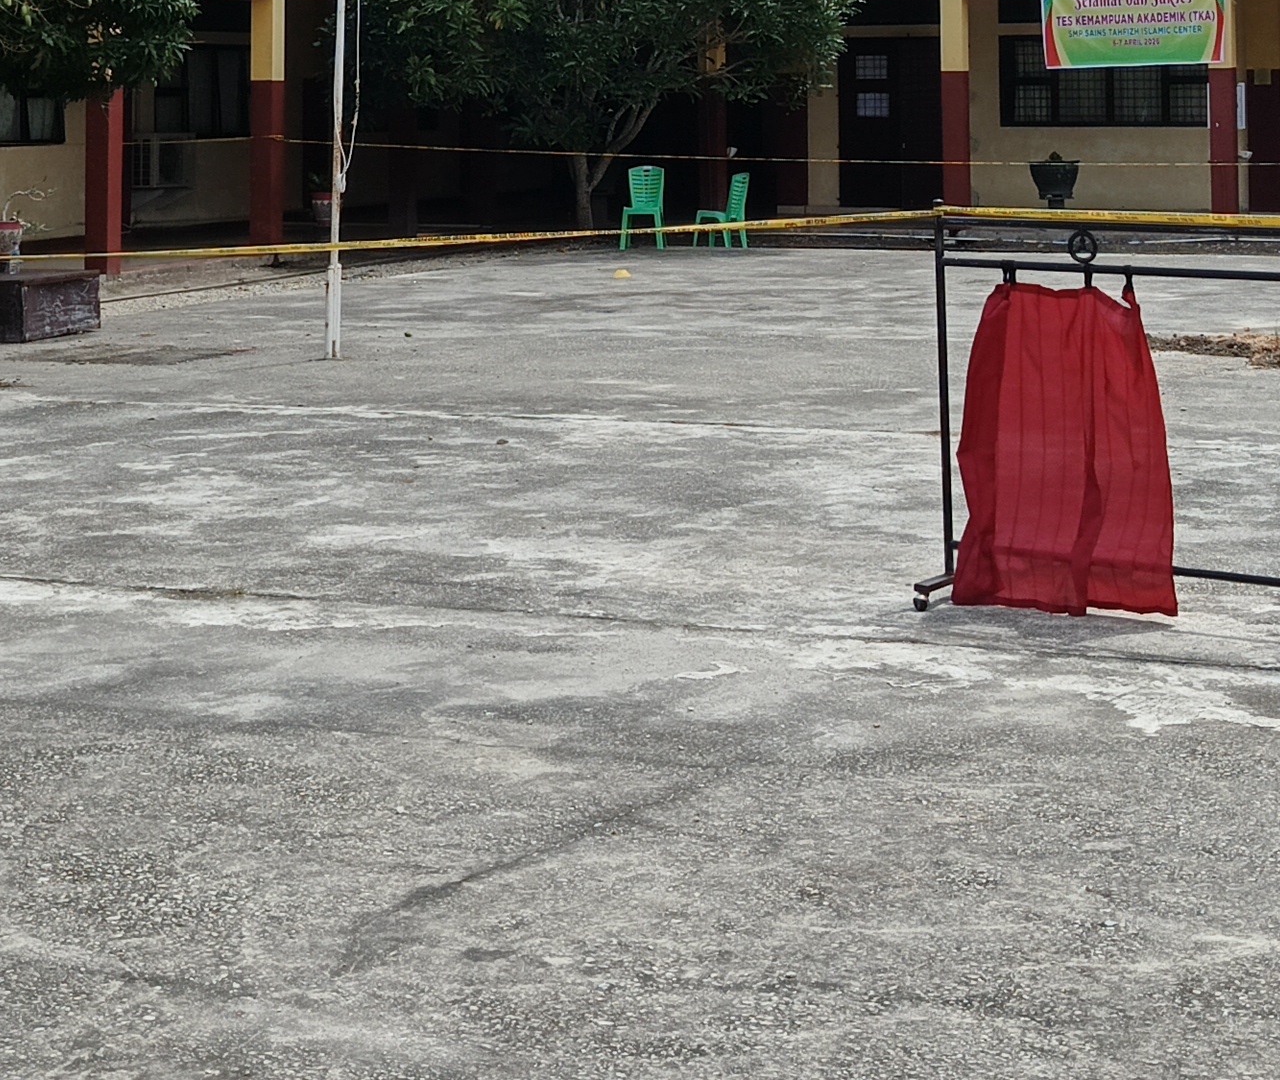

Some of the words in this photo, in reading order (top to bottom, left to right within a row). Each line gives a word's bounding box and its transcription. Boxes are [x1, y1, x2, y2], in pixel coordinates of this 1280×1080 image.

[1056, 15, 1073, 27] TES
[1075, 13, 1134, 26] KEMAMPUAN
[1137, 11, 1186, 24] AKADEMIK
[1189, 10, 1216, 23] (TKA)
[1068, 29, 1084, 38] SMP
[1085, 28, 1107, 37] SAINS
[1108, 27, 1139, 36] TAHFIZH
[1141, 26, 1172, 35] ISLAMIC
[1173, 25, 1203, 34] CENTER
[1124, 38, 1143, 46] APRIL
